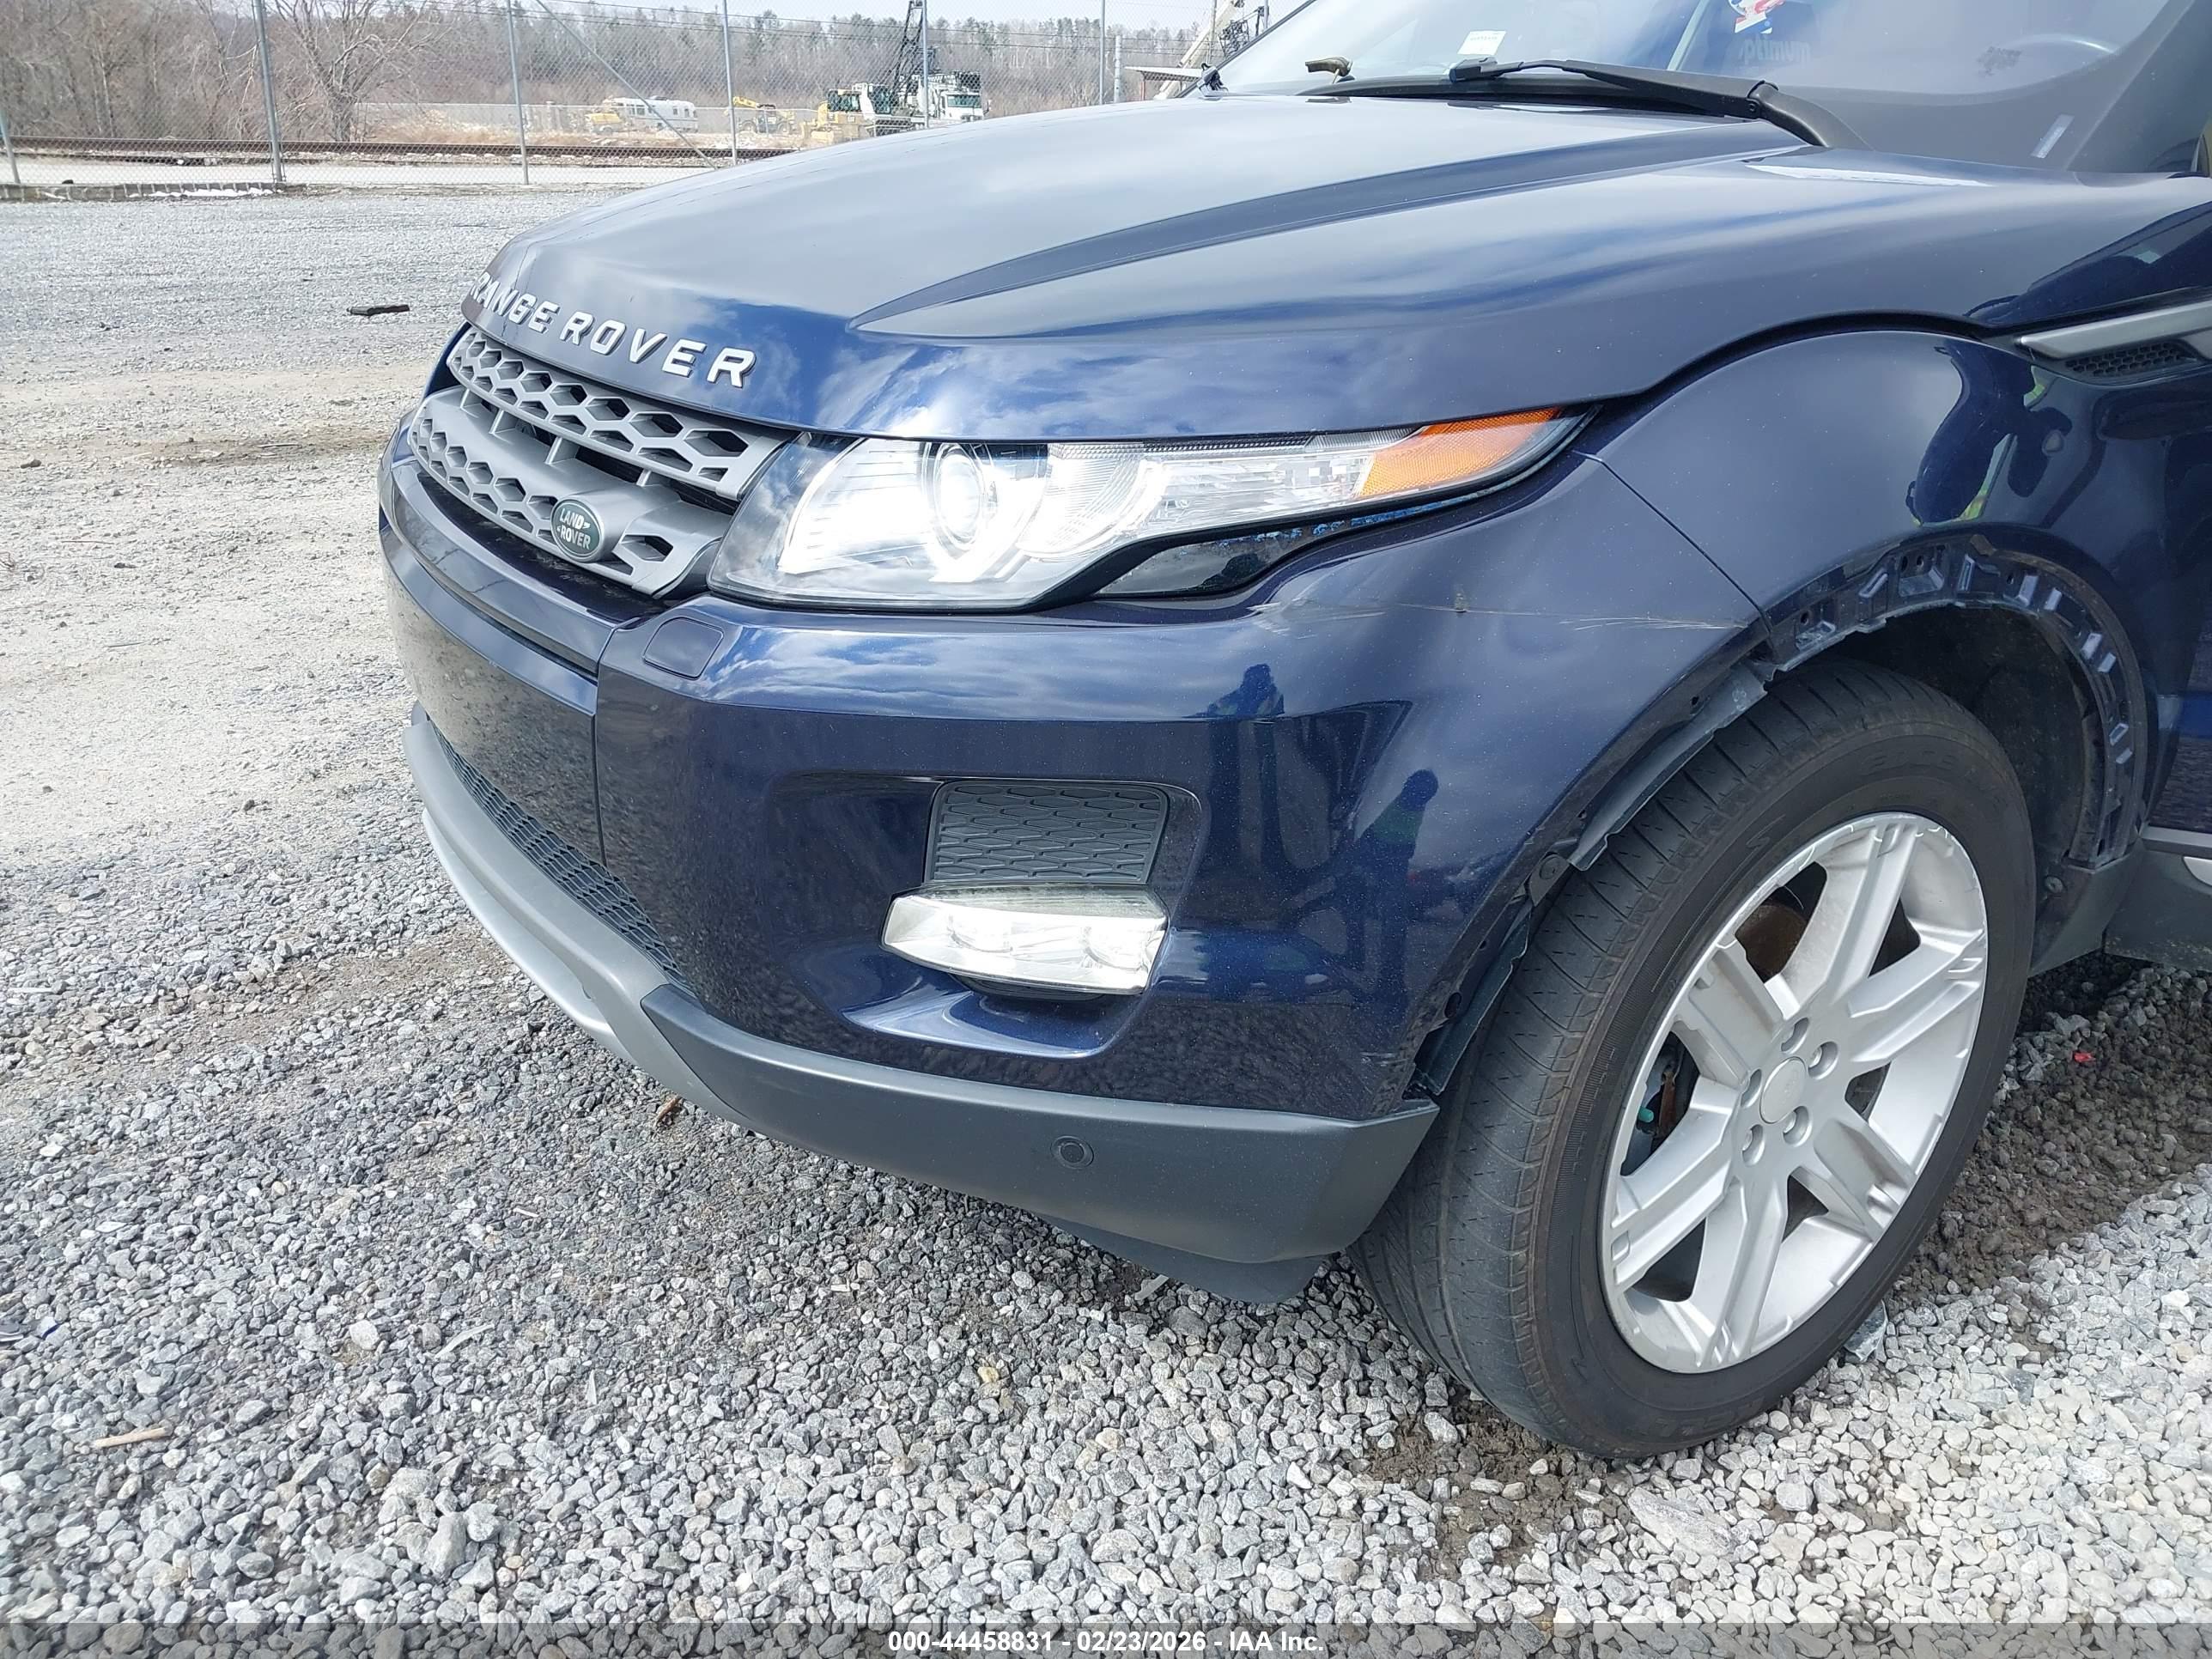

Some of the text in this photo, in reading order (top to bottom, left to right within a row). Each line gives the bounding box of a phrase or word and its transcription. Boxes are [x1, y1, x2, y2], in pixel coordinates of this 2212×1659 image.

[470, 271, 756, 388] RANGE ROVER
[559, 507, 585, 530] LAND
[560, 524, 591, 550] ROVER
